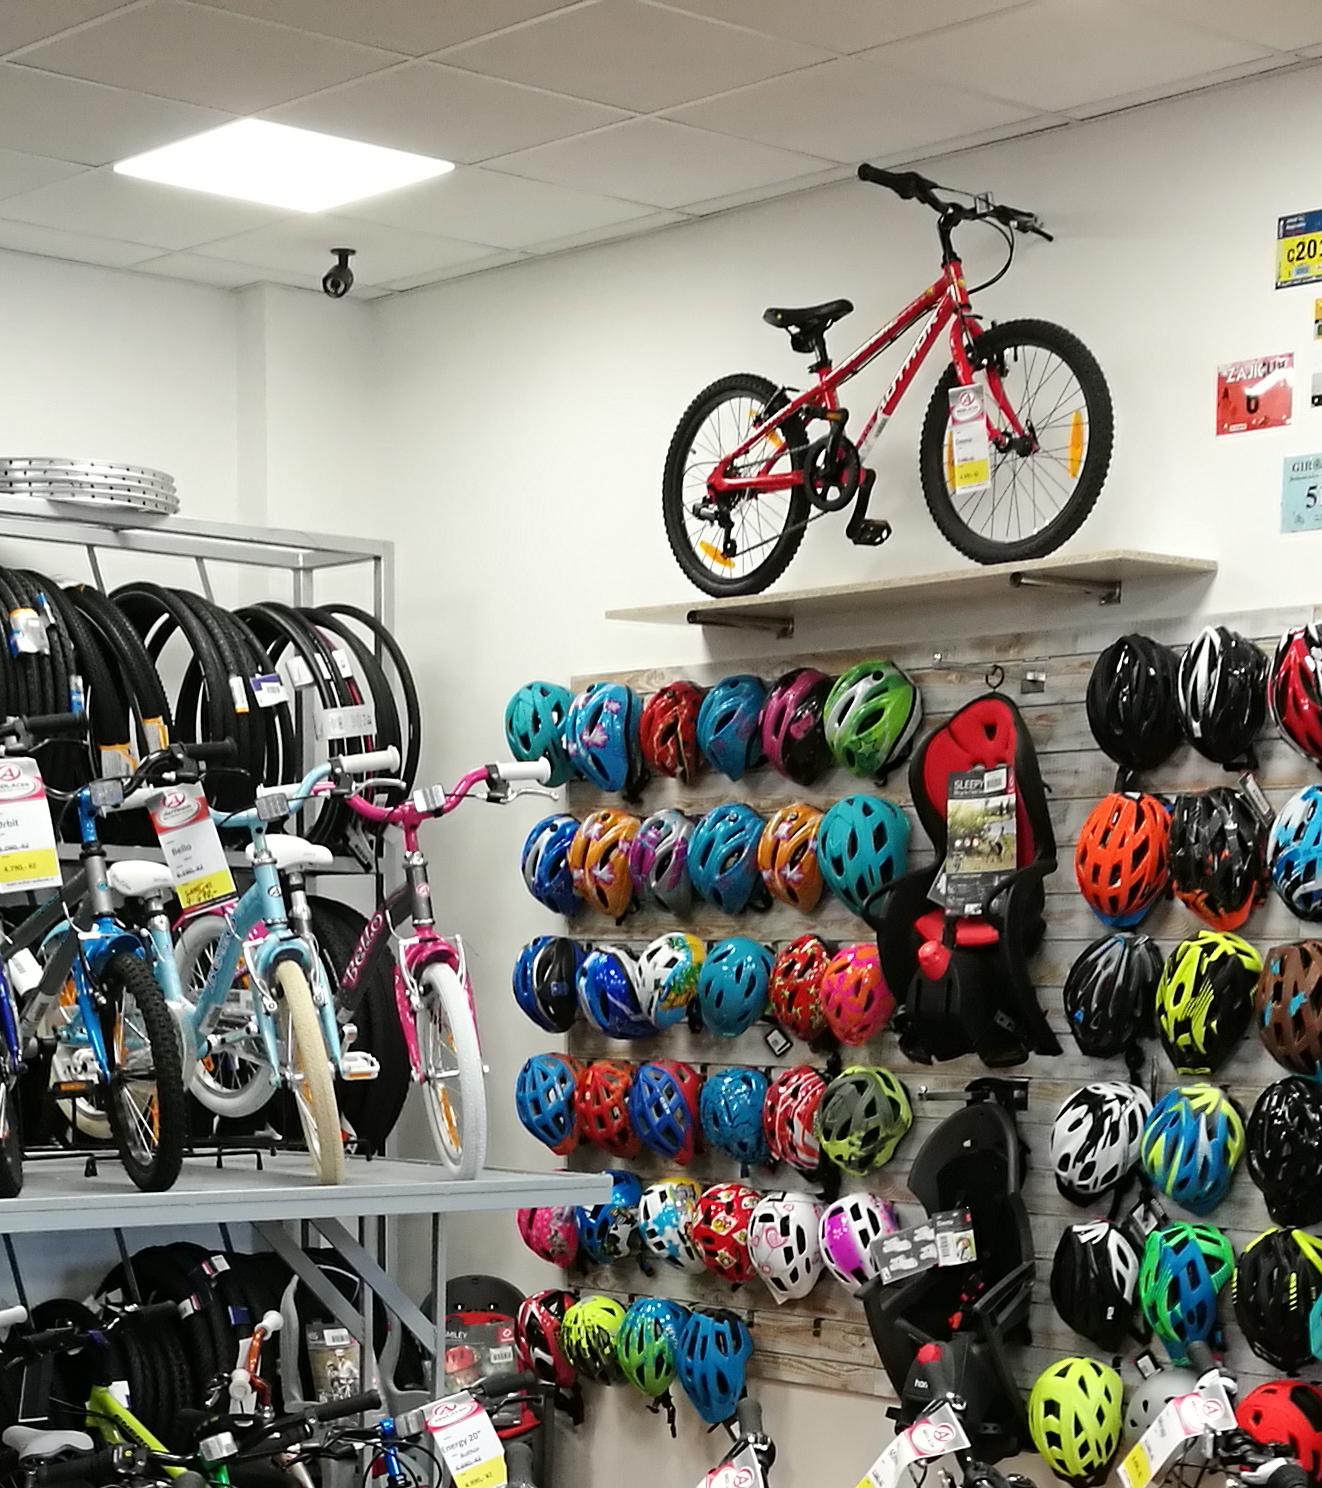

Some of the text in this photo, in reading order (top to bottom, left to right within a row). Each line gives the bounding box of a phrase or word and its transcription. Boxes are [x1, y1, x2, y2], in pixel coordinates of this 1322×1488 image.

[954, 780, 984, 791] SLEEPY
[171, 844, 192, 855] Bello
[441, 1437, 468, 1454] Energy
